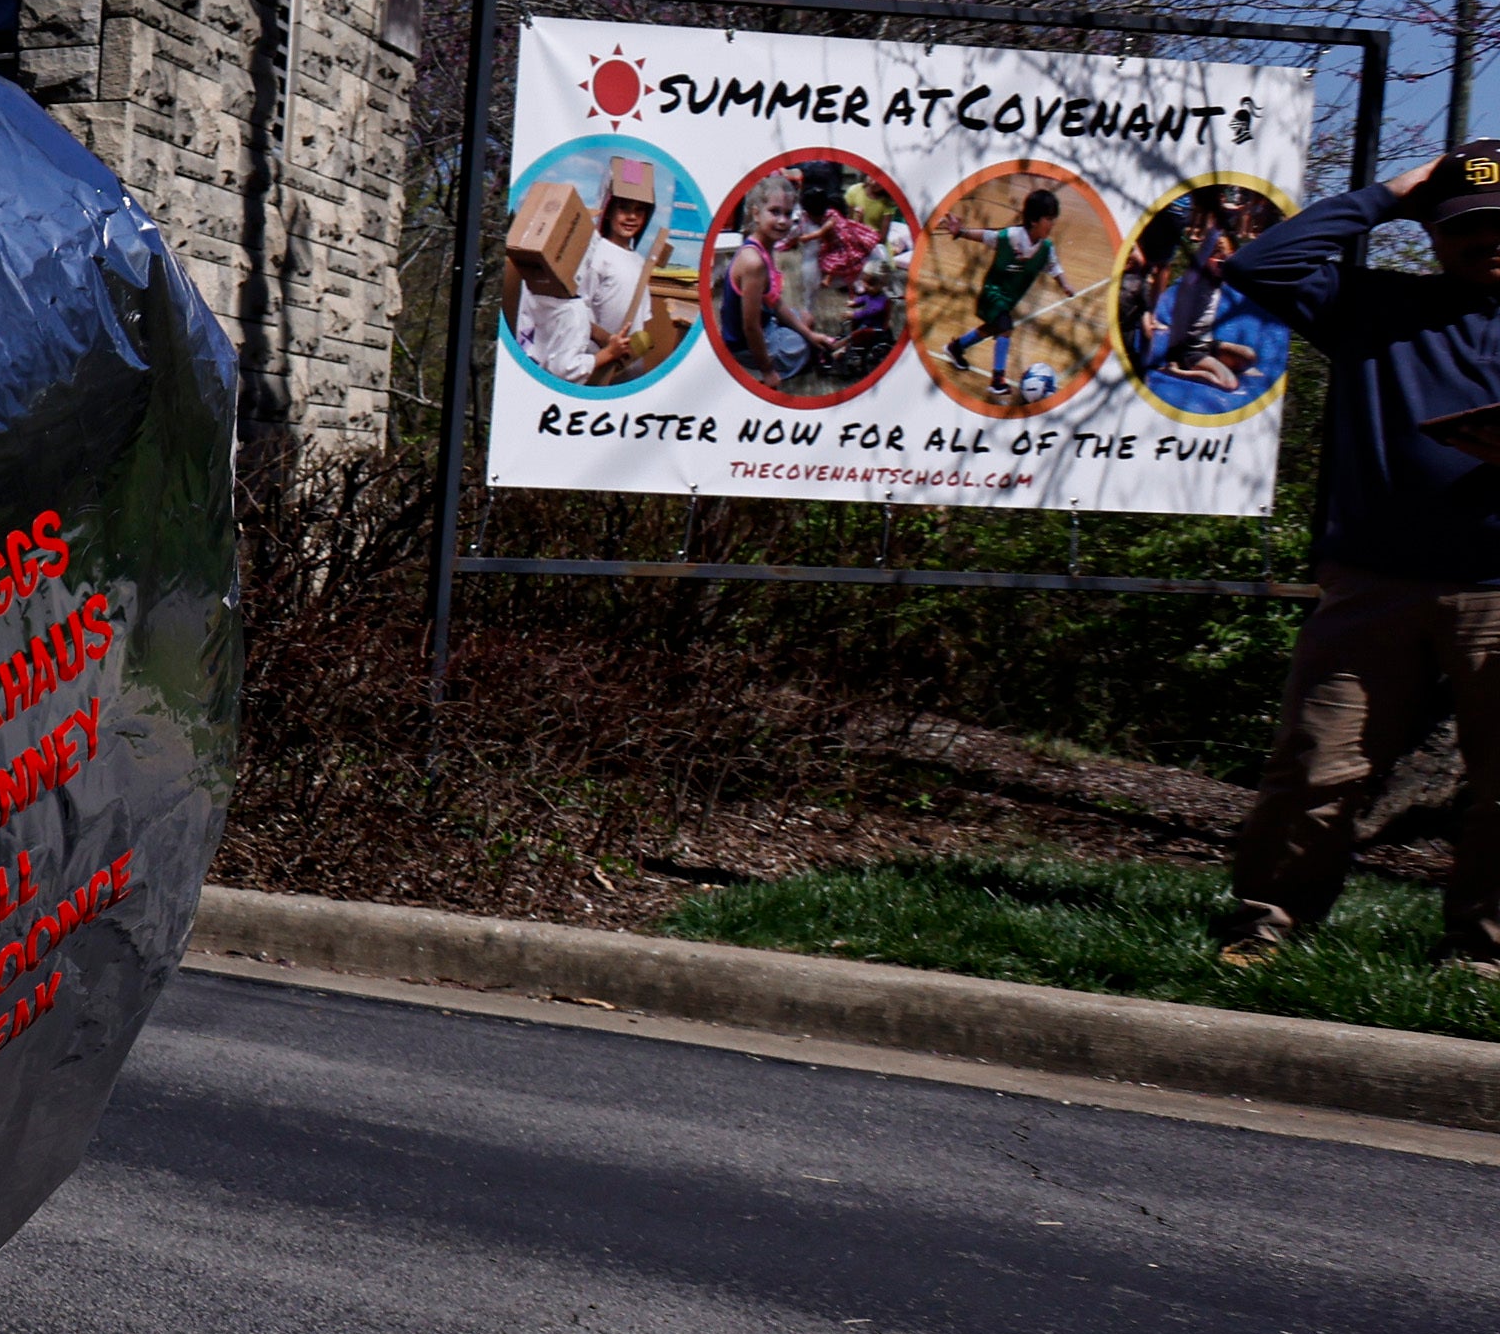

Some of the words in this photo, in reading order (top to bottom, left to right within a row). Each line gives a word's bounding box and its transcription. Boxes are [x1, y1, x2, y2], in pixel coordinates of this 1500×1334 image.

[659, 73, 870, 128] SUMMER
[883, 87, 954, 128] AT
[957, 84, 1226, 145] COVENANT
[538, 403, 718, 444] REGISTER
[737, 417, 823, 447] NOW
[839, 422, 905, 452] FOR
[924, 427, 991, 454] ALL
[1011, 430, 1059, 456] OF
[1072, 433, 1138, 460] THE
[1155, 433, 1234, 464] FUN!
[730, 461, 1033, 489] THECOVENANTSCHOOL.COM
